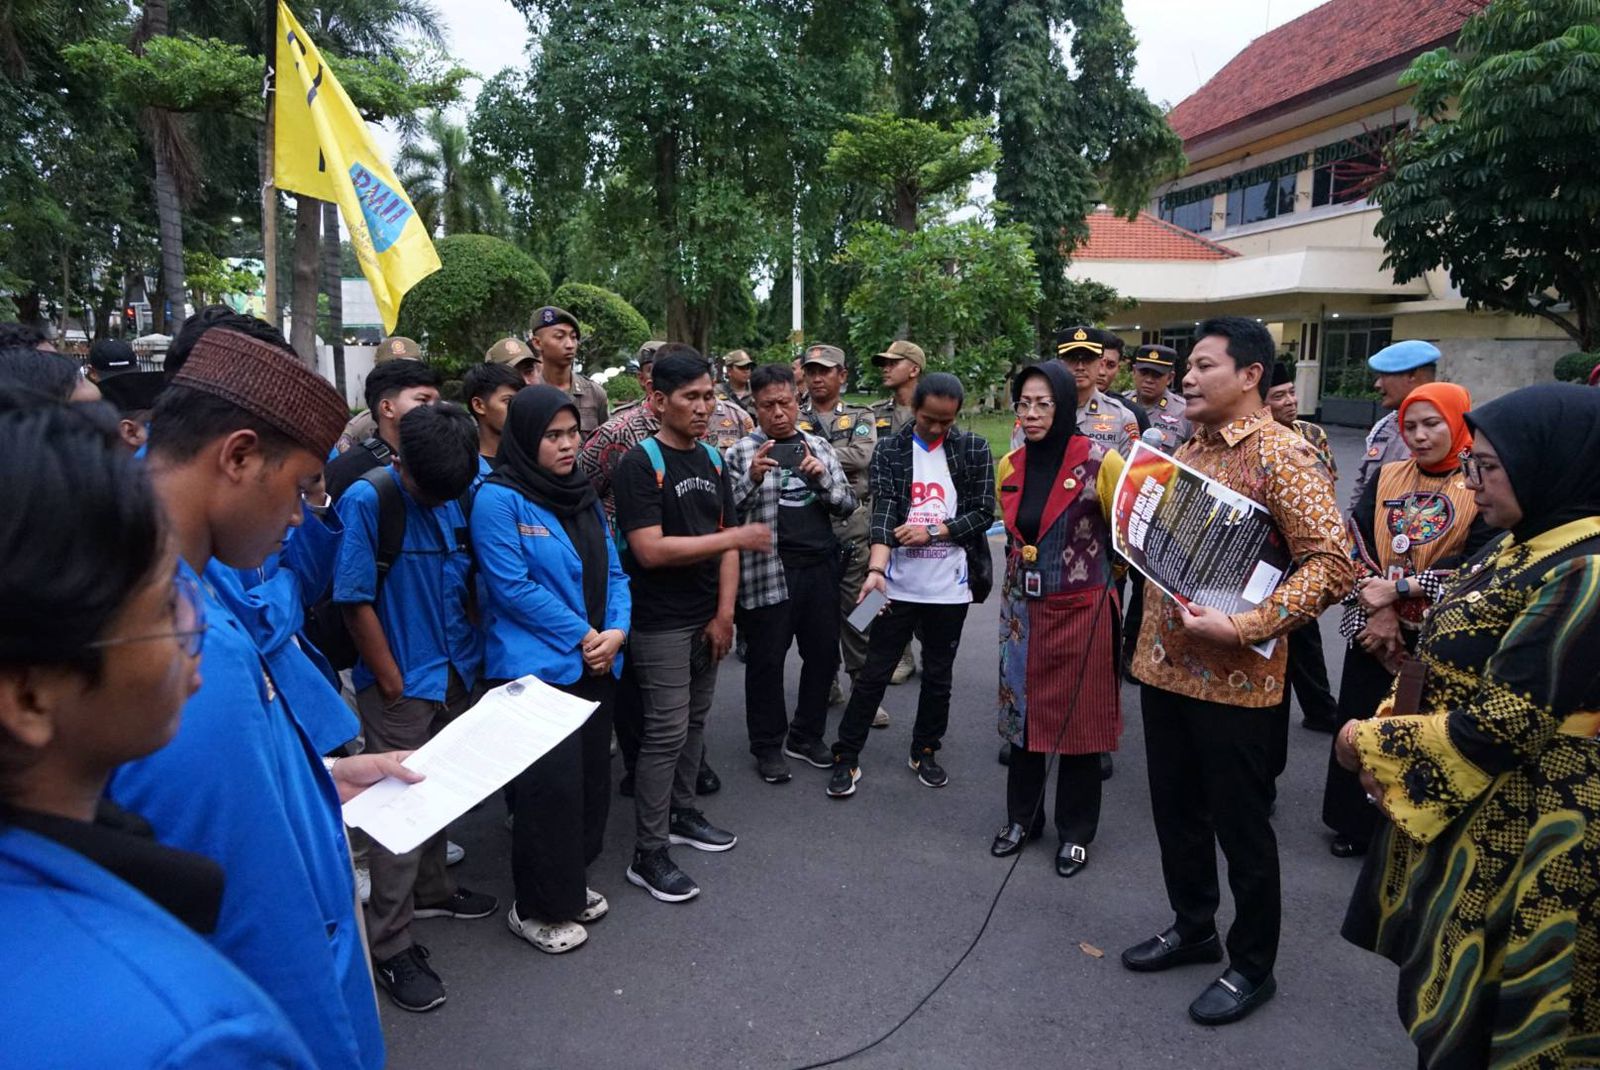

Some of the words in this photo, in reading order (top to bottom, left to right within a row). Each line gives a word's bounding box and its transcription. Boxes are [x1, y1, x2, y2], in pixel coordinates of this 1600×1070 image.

[1153, 422, 1178, 432] POLRI
[1132, 493, 1148, 514] AKSI
[1142, 483, 1165, 522] SIDOARJO
